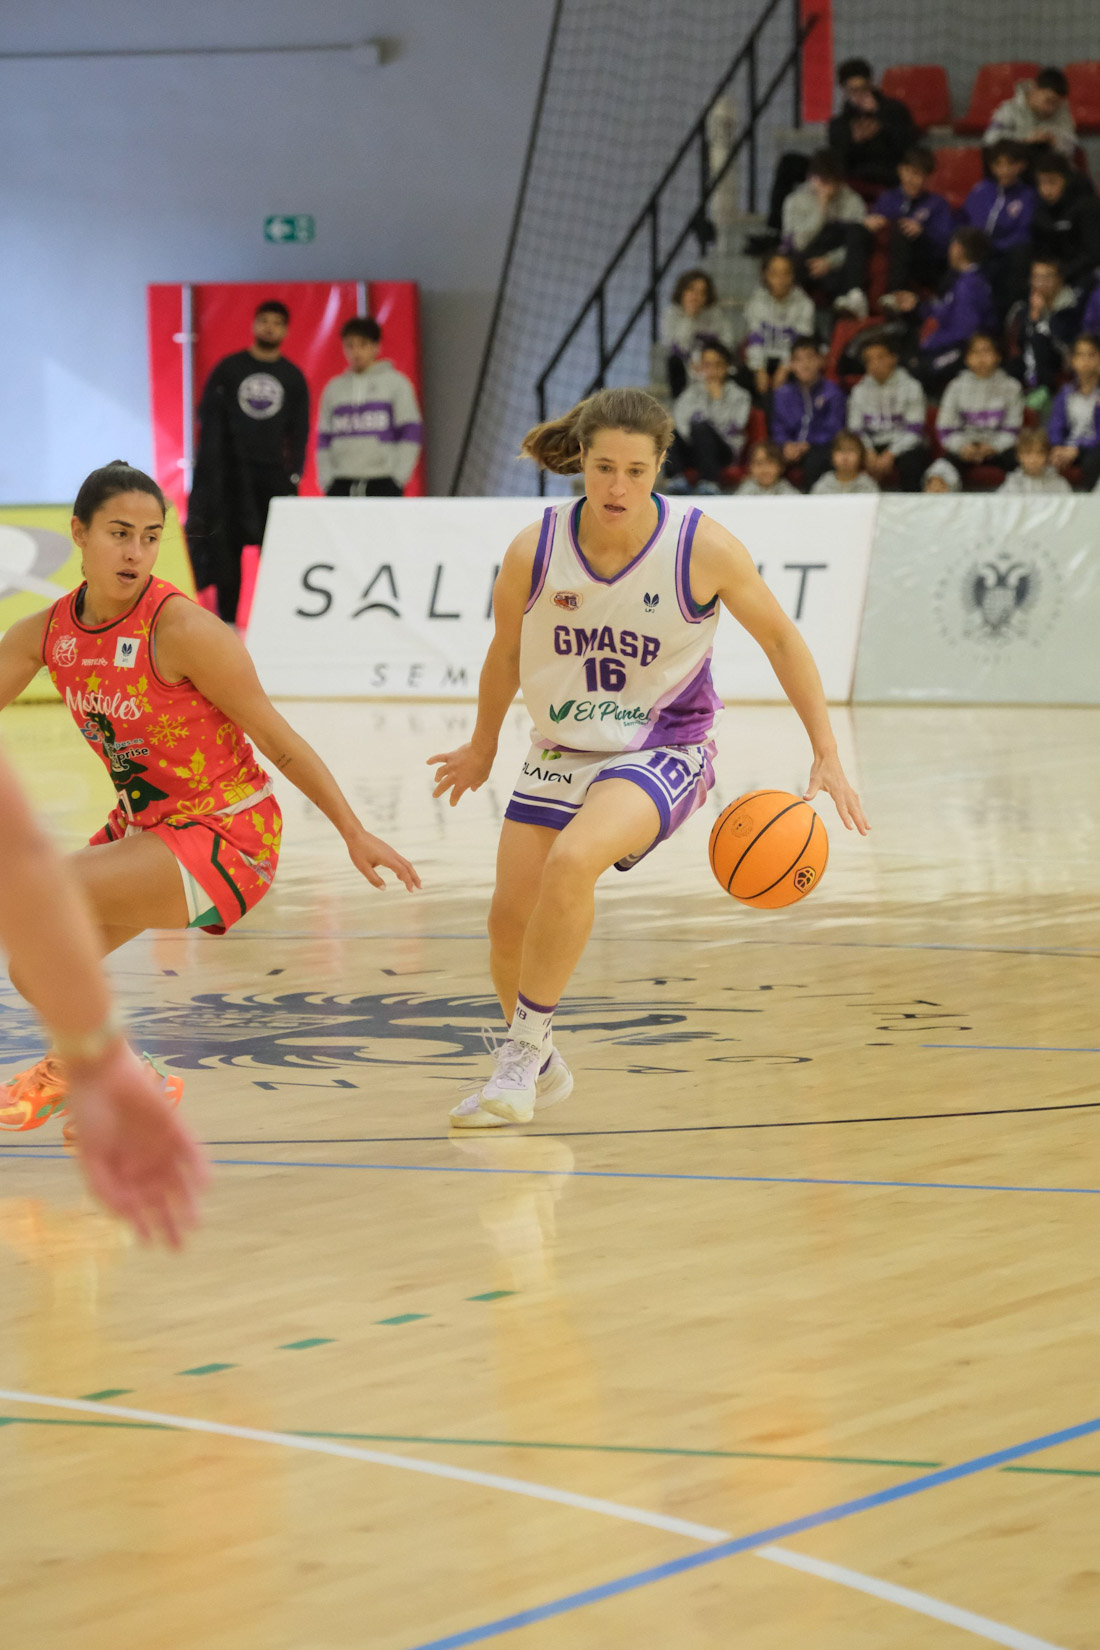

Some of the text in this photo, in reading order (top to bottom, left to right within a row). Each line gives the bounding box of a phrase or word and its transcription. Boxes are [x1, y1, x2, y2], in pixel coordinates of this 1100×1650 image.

[554, 625, 661, 668] GMASB
[582, 657, 627, 693] 16
[573, 700, 597, 722] El
[645, 750, 693, 791] 16
